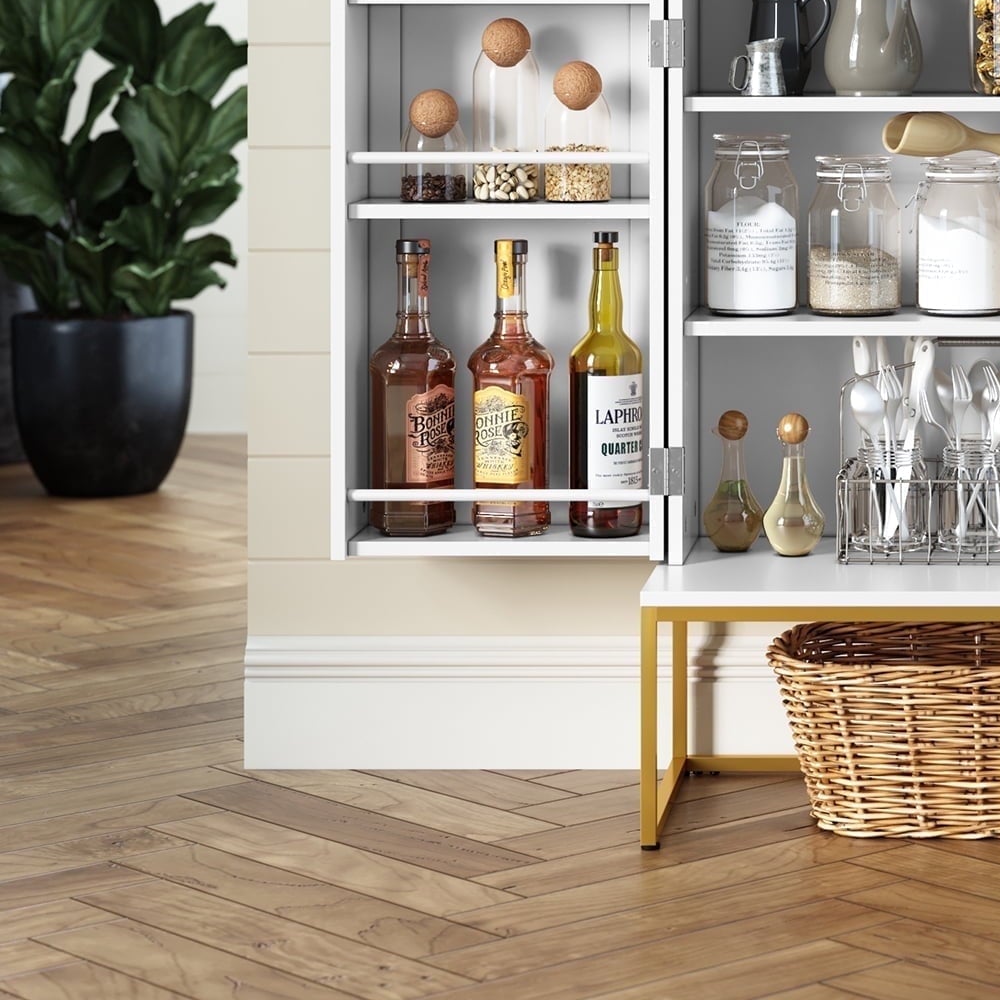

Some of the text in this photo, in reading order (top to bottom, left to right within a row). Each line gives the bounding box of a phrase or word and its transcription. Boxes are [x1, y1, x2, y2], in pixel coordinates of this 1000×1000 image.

[475, 408, 522, 429] ONNIE
[420, 422, 448, 447] ROSE
[601, 441, 638, 456] QUARTER
